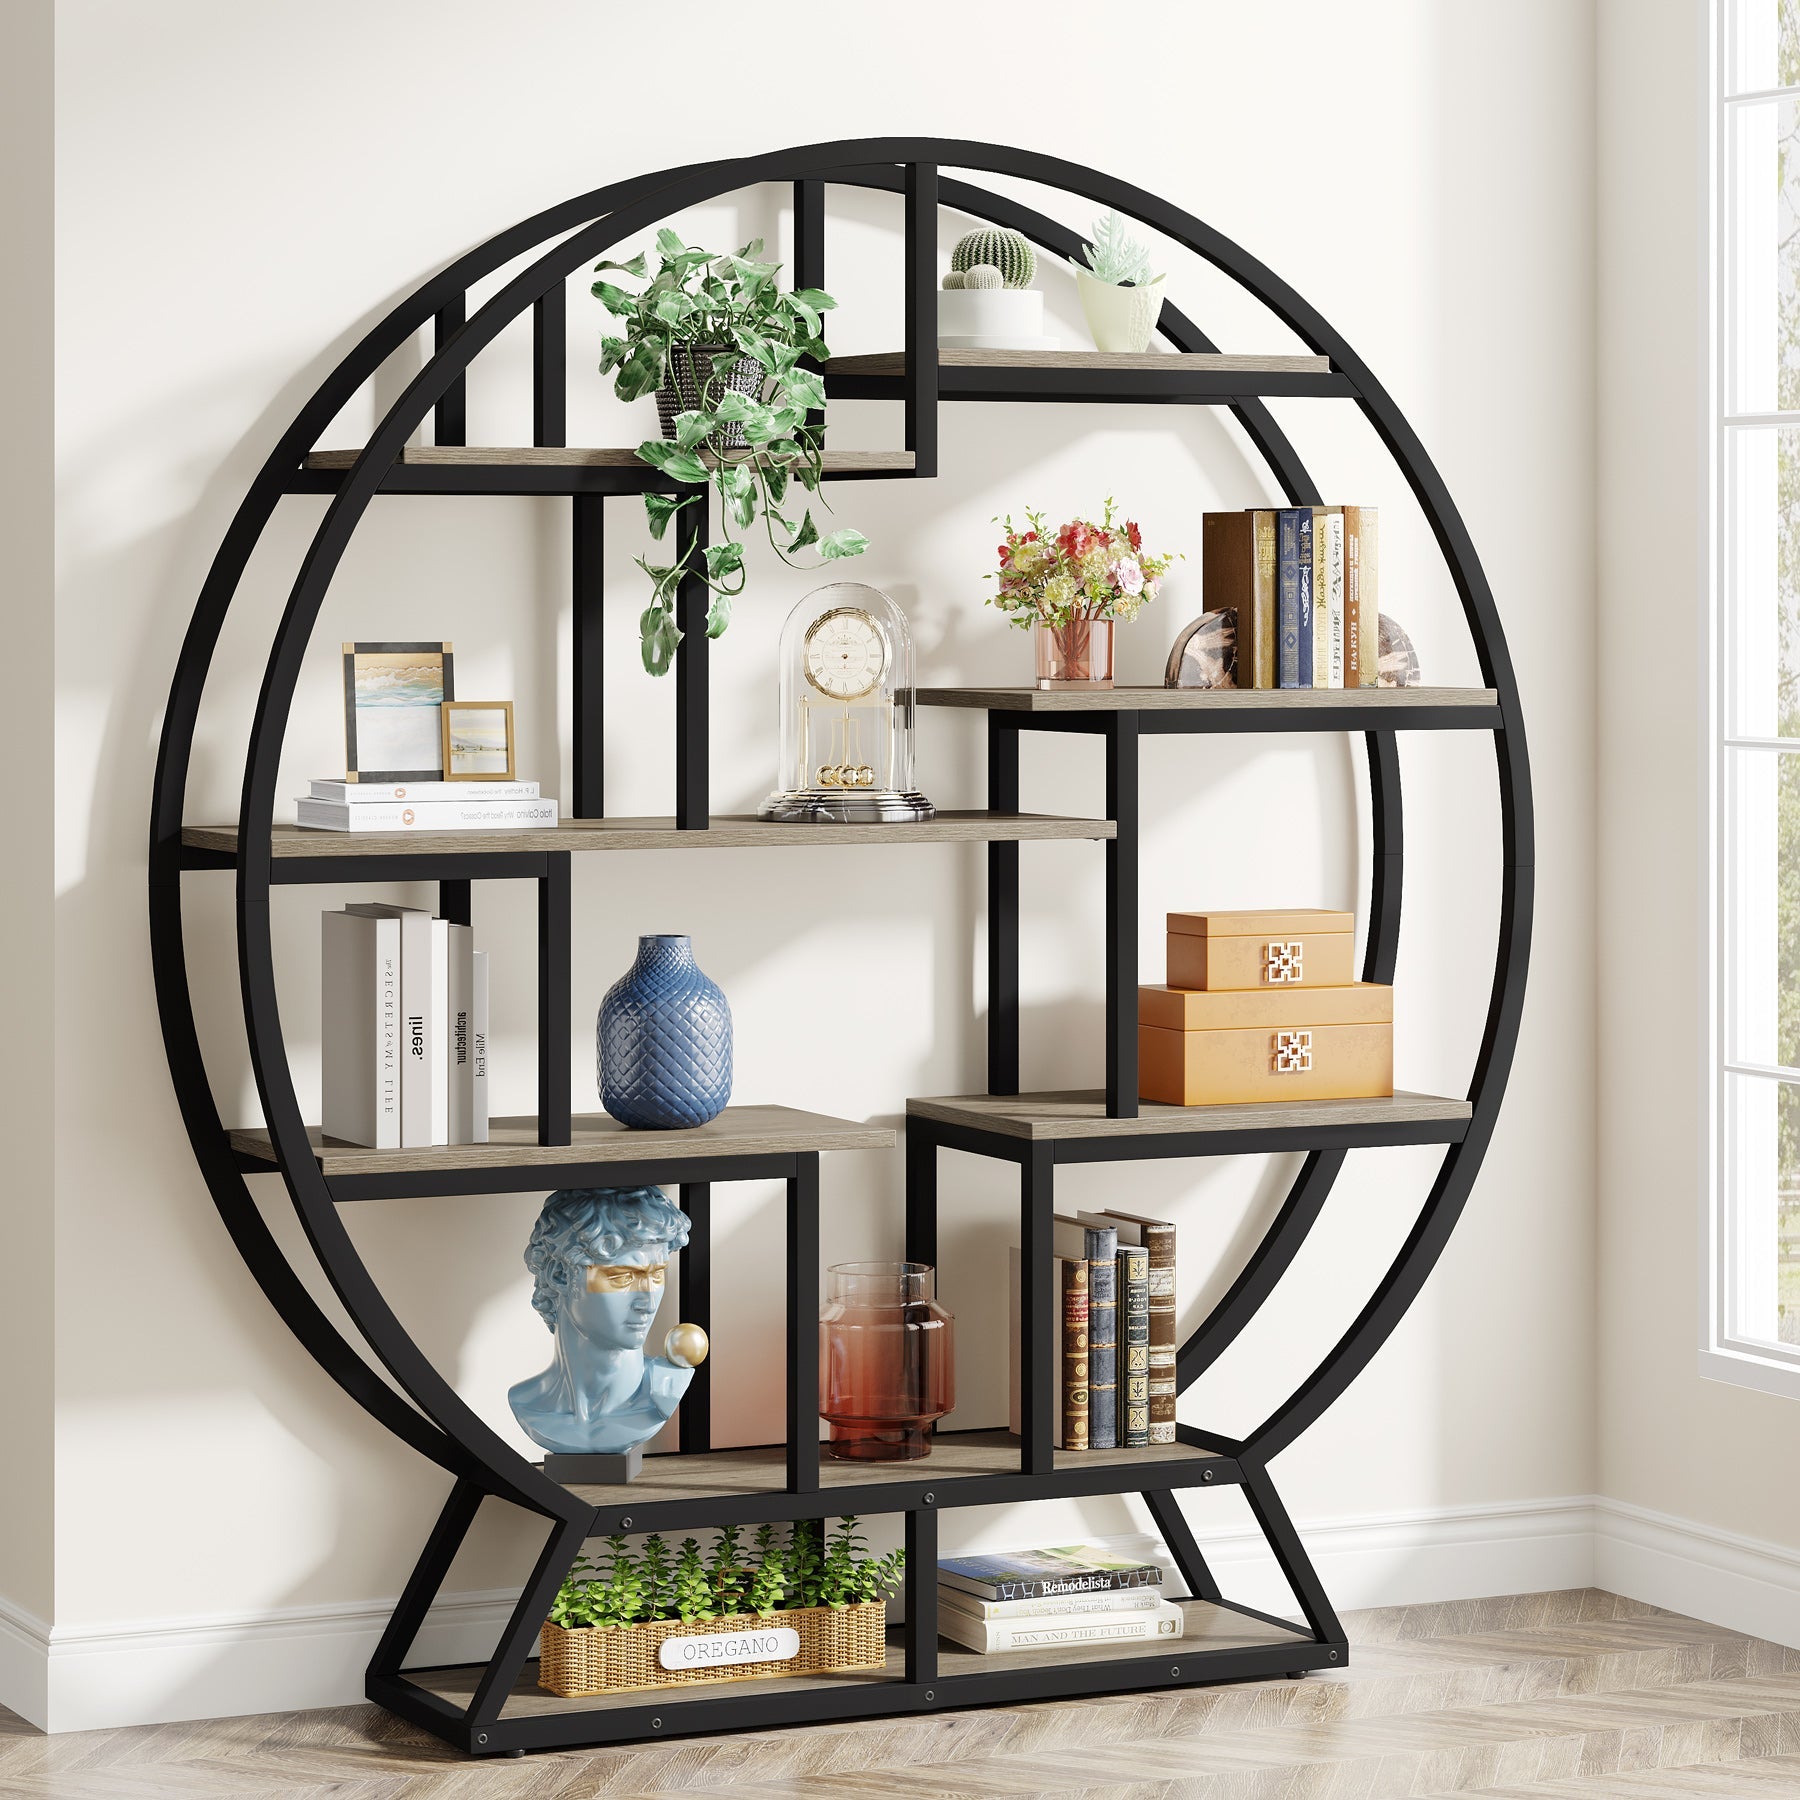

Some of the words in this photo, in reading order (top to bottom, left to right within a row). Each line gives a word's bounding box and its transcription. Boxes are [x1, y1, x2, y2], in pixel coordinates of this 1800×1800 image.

[1318, 524, 1327, 563] жизни
[1316, 566, 1327, 609] Жажда
[1042, 1576, 1112, 1595] Remodelista
[1053, 1605, 1071, 1615] Don't
[1073, 1603, 1090, 1614] They
[1091, 1603, 1112, 1612] What
[1012, 1631, 1039, 1645] MAN
[1043, 1629, 1068, 1642] AND
[1073, 1627, 1097, 1639] THE
[1100, 1624, 1147, 1637] FUTURE
[683, 1636, 779, 1661] OREGANO
